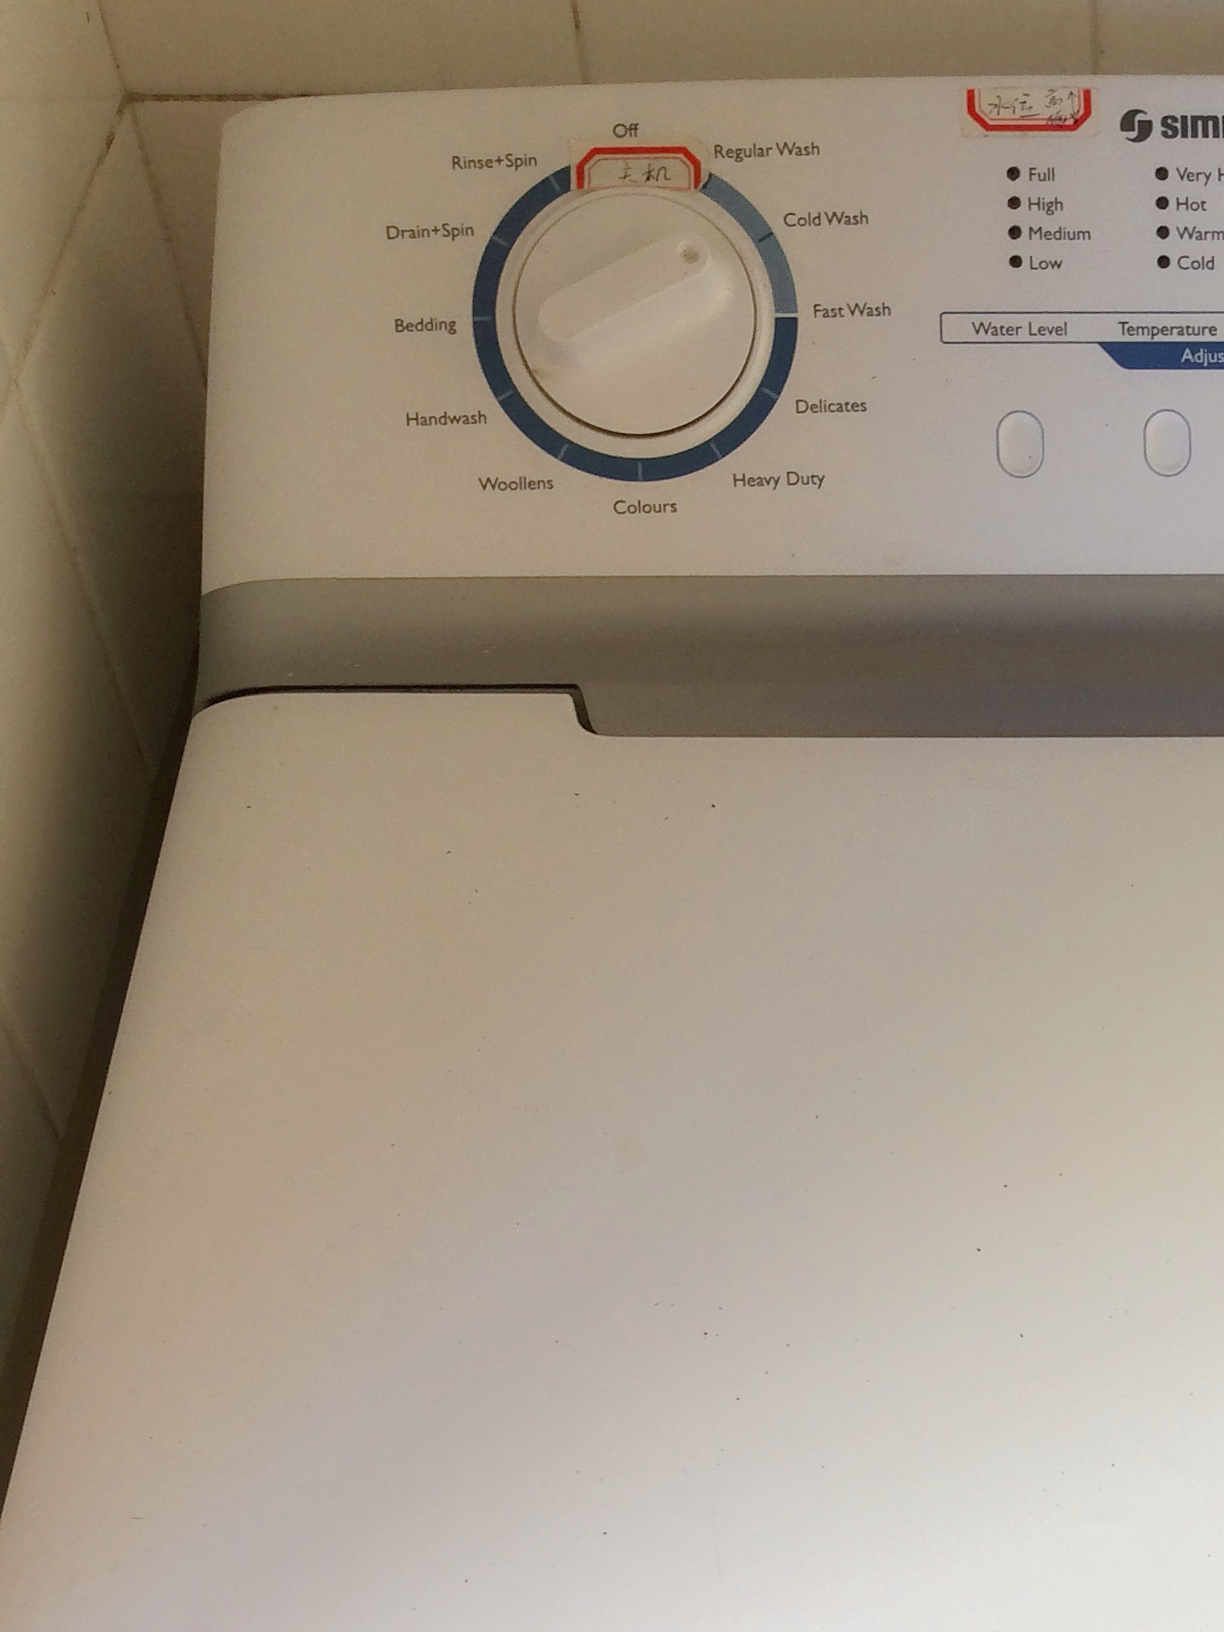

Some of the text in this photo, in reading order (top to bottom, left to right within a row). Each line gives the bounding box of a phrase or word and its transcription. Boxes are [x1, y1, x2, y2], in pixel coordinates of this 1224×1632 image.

[612, 122, 640, 139] Off
[713, 141, 821, 163] Regular Wash
[451, 152, 538, 172] Rinse+Spin
[1028, 167, 1056, 183] Full
[1175, 167, 1212, 187] Very
[1027, 196, 1064, 216] High
[1175, 196, 1207, 212] Hot
[783, 210, 869, 228] Cold Wash
[385, 222, 475, 242] Drain+Spin
[1028, 225, 1092, 241] Medium
[1029, 255, 1063, 271] Low
[1176, 255, 1215, 271] Cold
[812, 301, 892, 319] Fast Wash
[394, 317, 457, 336] Bedding
[971, 321, 1068, 337] Water Level
[1117, 321, 1218, 341] Temperature
[795, 398, 868, 415] Delicates
[405, 409, 487, 427] Handwash
[477, 476, 555, 492] Woollens
[732, 470, 826, 491] Heavy Duty
[612, 499, 678, 515] Colours
